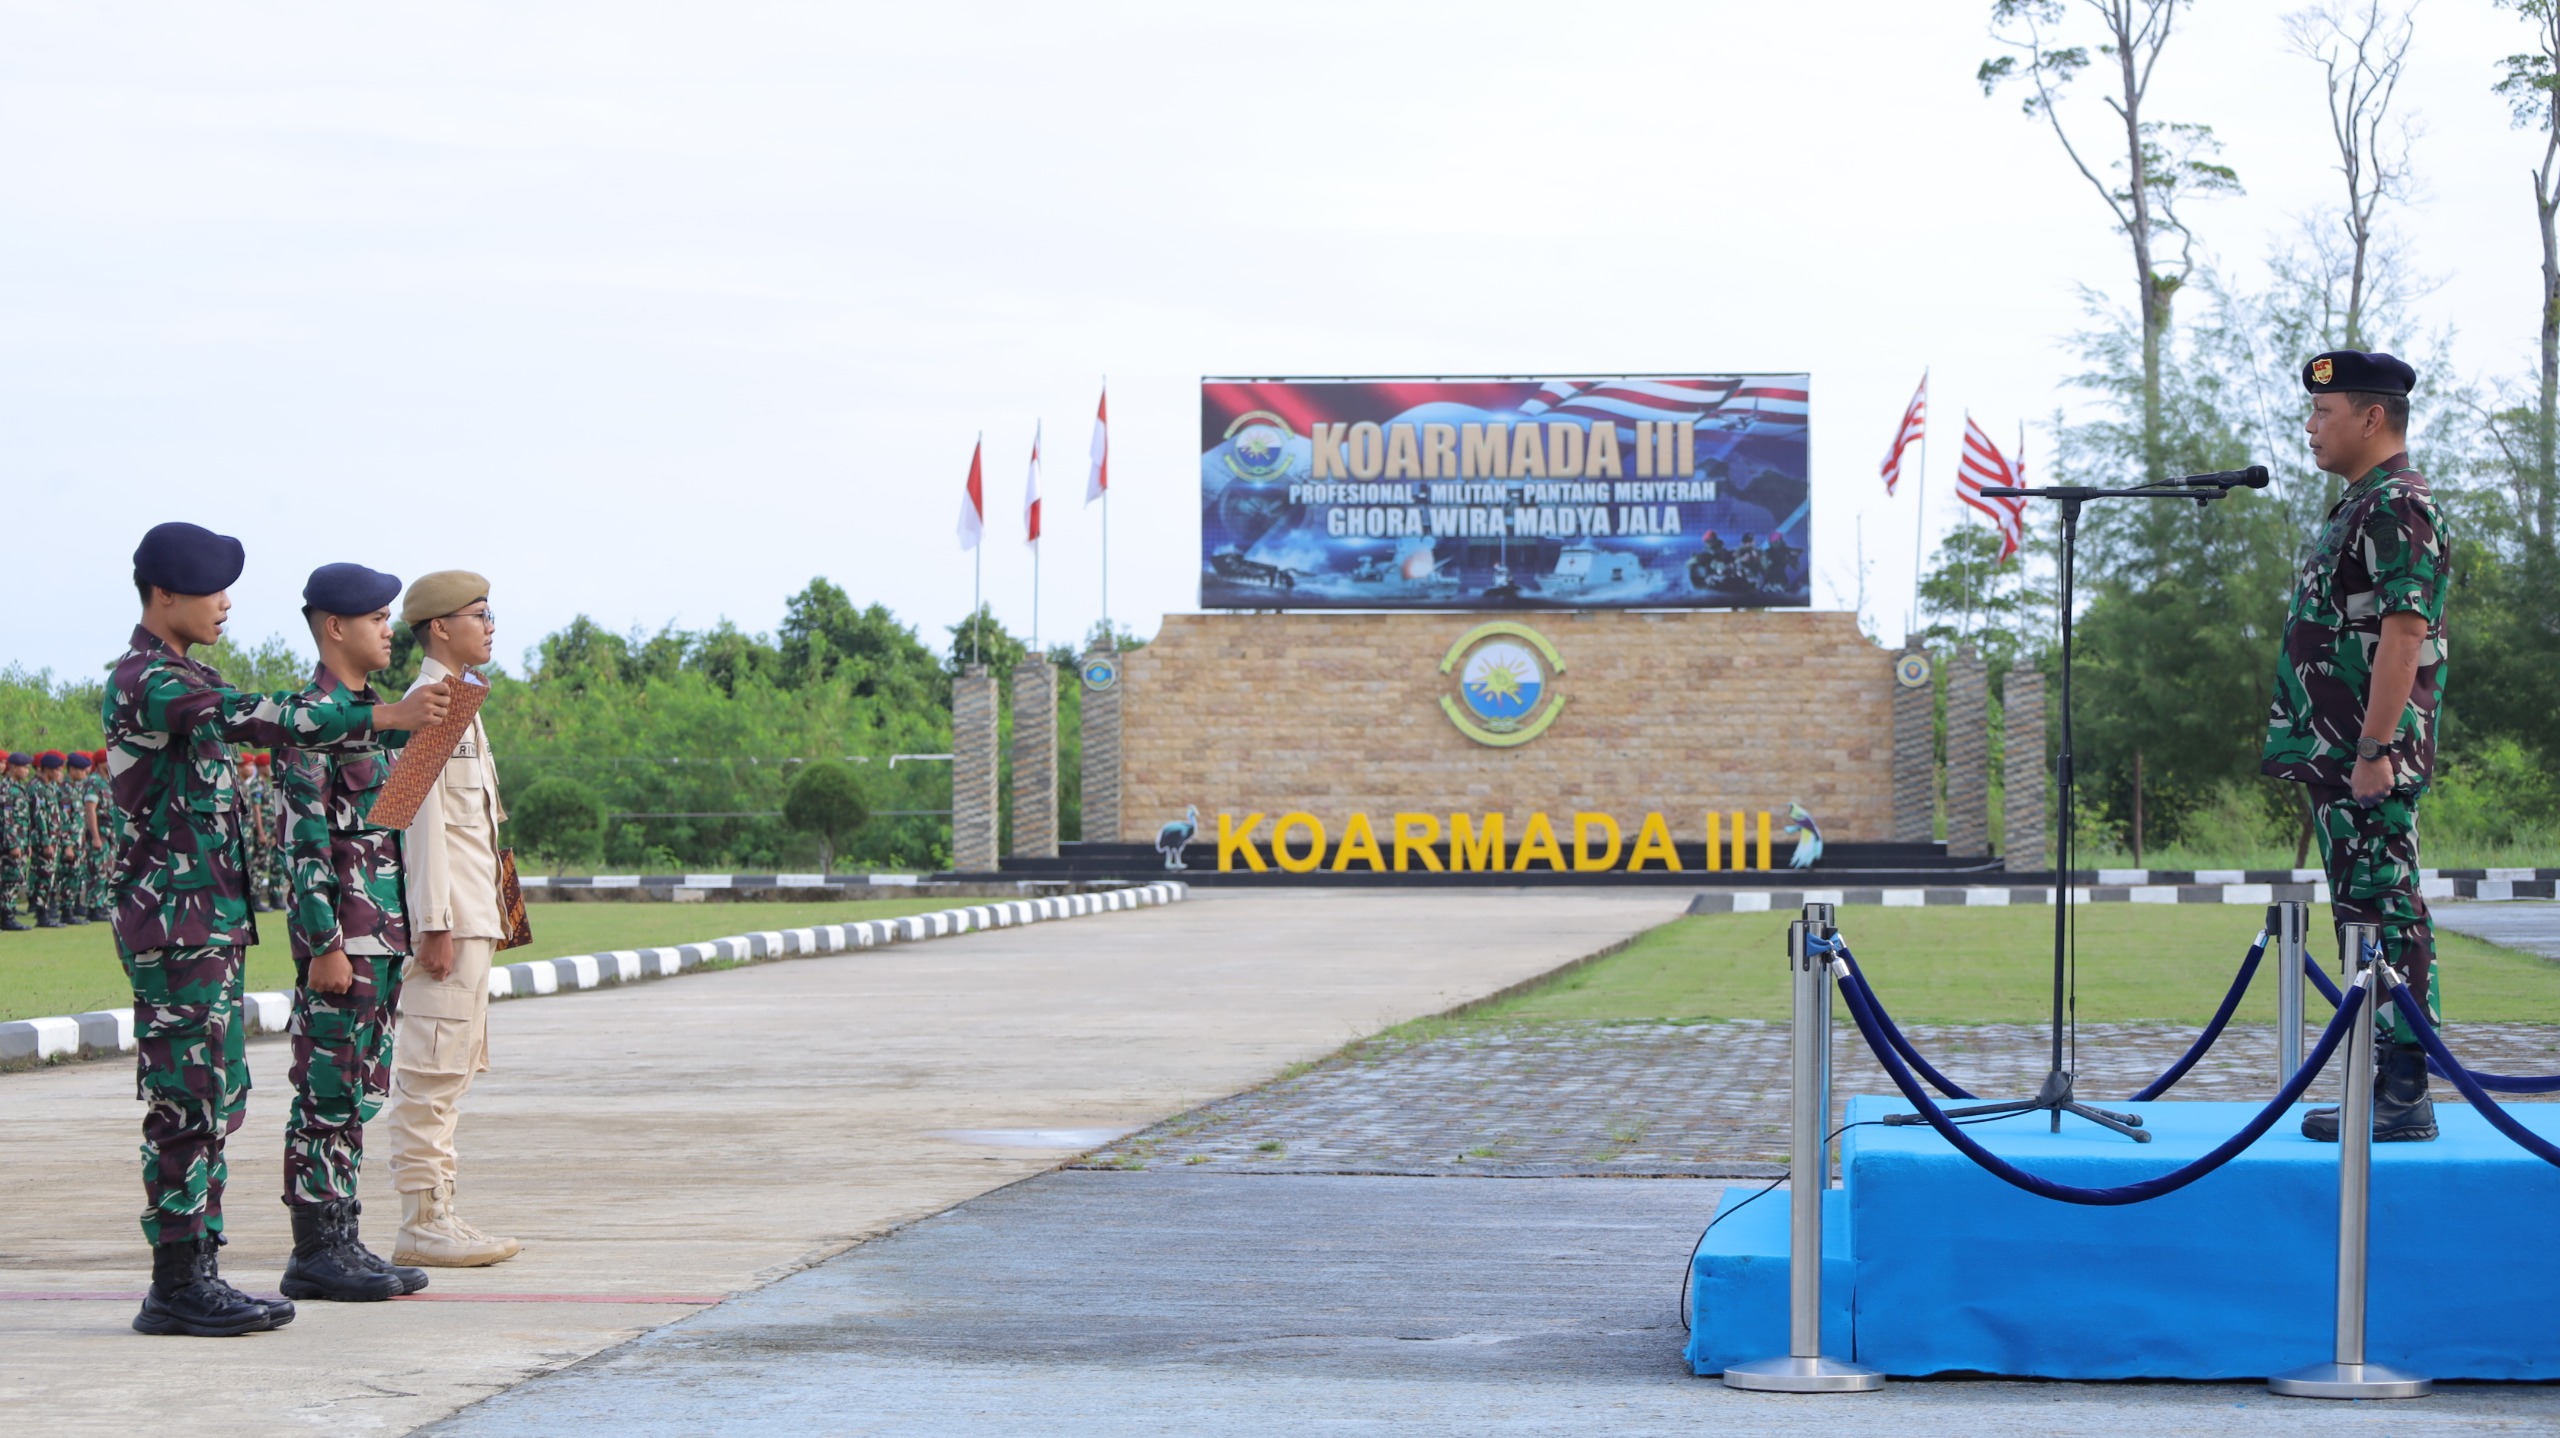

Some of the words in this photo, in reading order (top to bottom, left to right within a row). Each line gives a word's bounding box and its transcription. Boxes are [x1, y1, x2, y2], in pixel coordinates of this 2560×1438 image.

[1311, 421, 1623, 480] KOARMADA
[1635, 420, 1695, 478] III
[1289, 484, 1415, 504] PROFESIONAL
[1430, 483, 1507, 504] MILITAN
[1523, 482, 1610, 503] PANTANG
[1614, 481, 1716, 502] MENYERAH
[1327, 507, 1424, 537] GHORA
[1429, 507, 1507, 537] WIRA
[1514, 506, 1611, 536] MADYA
[1617, 505, 1681, 536] JALA
[1217, 811, 1683, 873] KOARMADA
[1706, 811, 1771, 872] III
